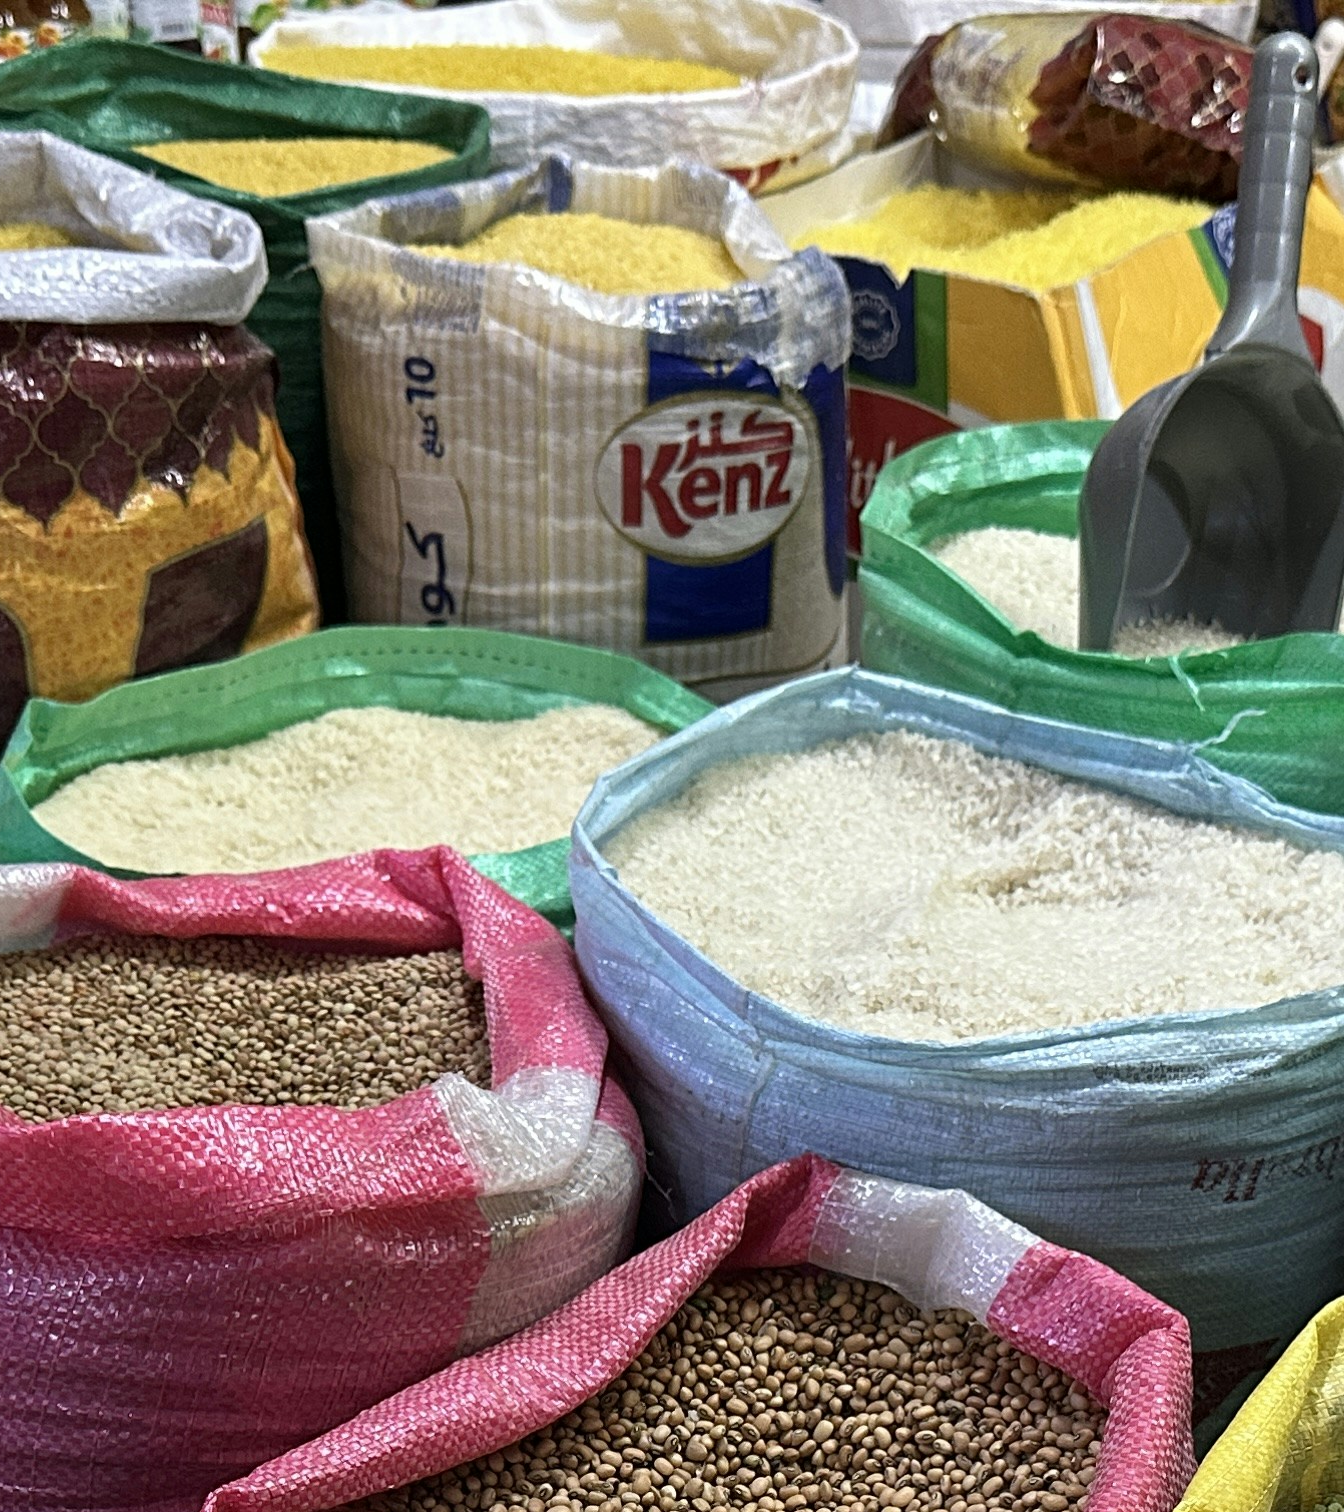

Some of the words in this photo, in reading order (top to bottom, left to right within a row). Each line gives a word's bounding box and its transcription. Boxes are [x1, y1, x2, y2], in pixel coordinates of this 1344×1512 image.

[404, 356, 436, 404] 10
[676, 409, 794, 473] كنز
[621, 441, 793, 539] Kenz
